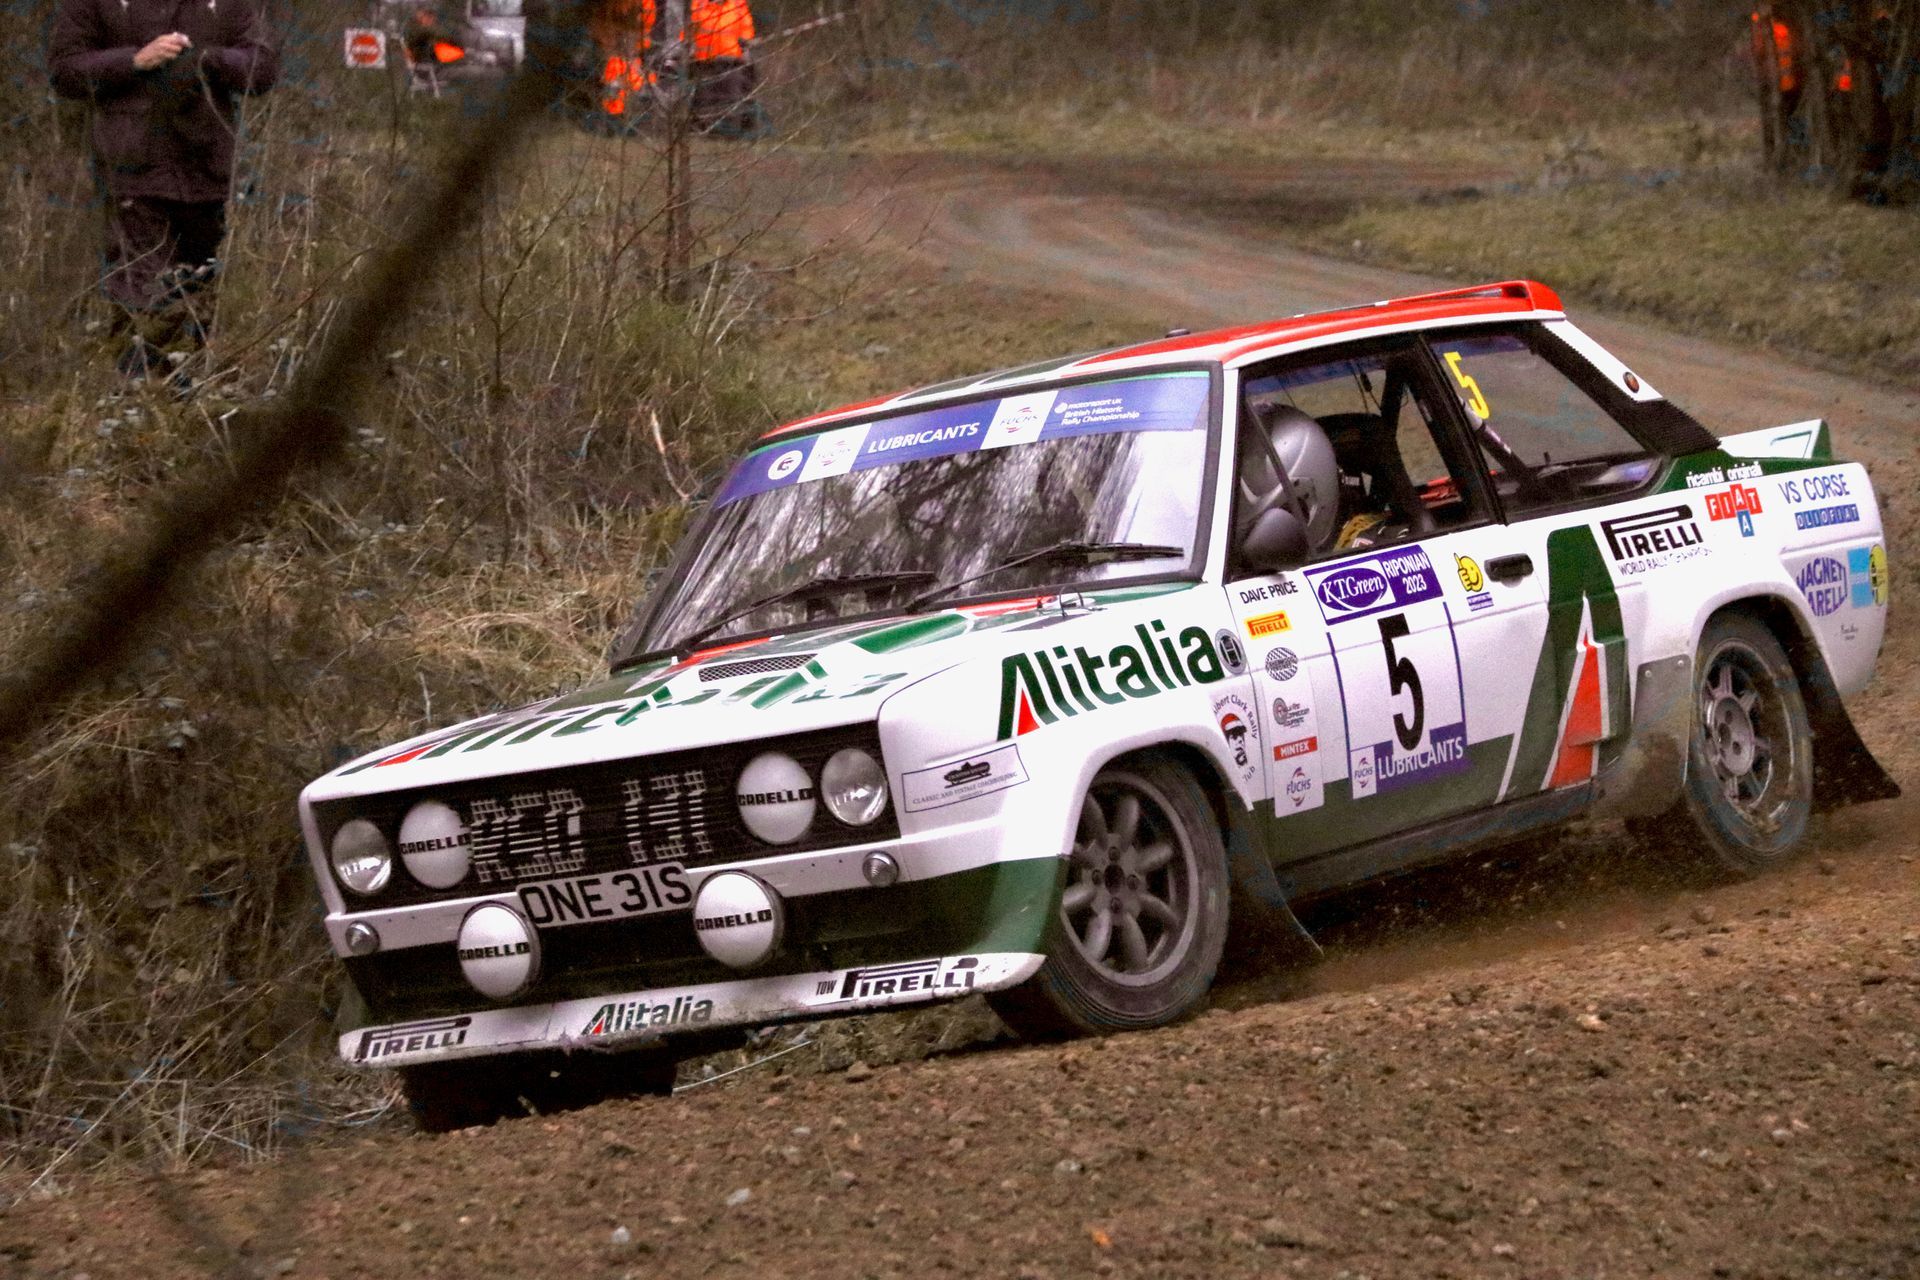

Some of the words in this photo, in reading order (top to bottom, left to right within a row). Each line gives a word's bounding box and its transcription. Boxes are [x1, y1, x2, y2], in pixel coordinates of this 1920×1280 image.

[1444, 351, 1489, 419] 5
[1061, 417, 1081, 426] Rally
[1082, 411, 1140, 423] Championship
[868, 422, 980, 453] LUBRICANTS
[1708, 487, 1758, 517] FIAT
[1778, 481, 1802, 504] VS
[1803, 473, 1850, 501] CORSE
[1600, 504, 1704, 560] PIRELLI
[1382, 552, 1430, 579] RIPONIAN
[1618, 560, 1646, 576] WORLD
[1240, 587, 1268, 604] DAVE
[1268, 581, 1298, 598] PRICE
[1403, 574, 1427, 594] 2023
[1247, 613, 1288, 636] PIRELLI
[997, 619, 1225, 742] Alitalia
[1377, 613, 1425, 751] 5
[1230, 694, 1248, 713] Clark
[1247, 711, 1258, 740] Rally
[1280, 739, 1311, 757] MINTEX
[1378, 737, 1464, 780] LUBRICANTS
[1286, 779, 1311, 796] FUCHS
[1354, 766, 1373, 779] FUCHS
[520, 877, 614, 925] ONE
[613, 865, 692, 912] 31S
[816, 979, 838, 996] TOW
[840, 957, 979, 999] PIRELLI
[581, 996, 713, 1036] Alitalia
[355, 1016, 472, 1062] PIRELLI
